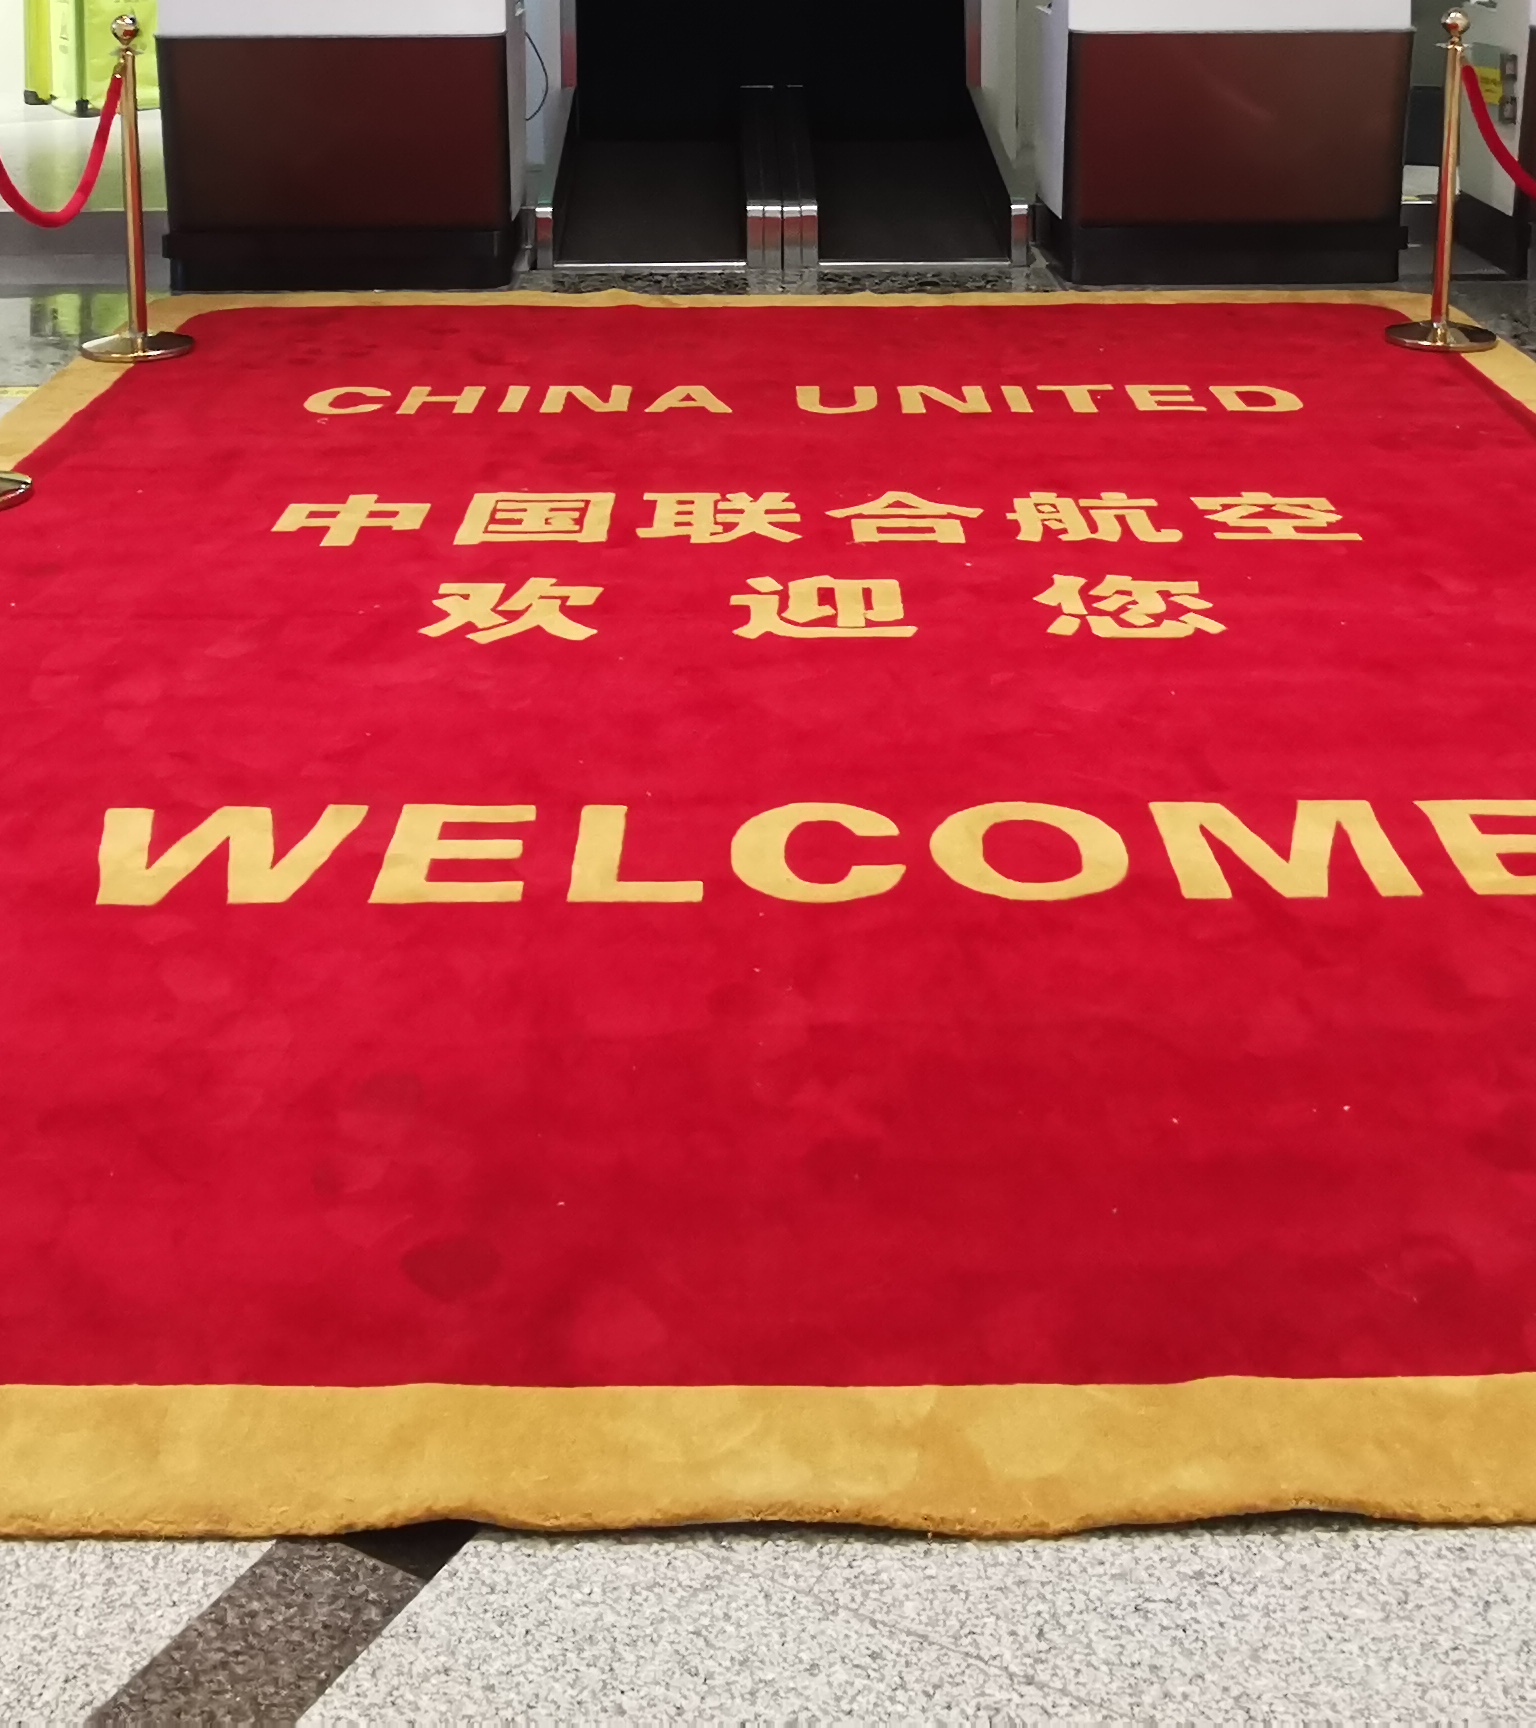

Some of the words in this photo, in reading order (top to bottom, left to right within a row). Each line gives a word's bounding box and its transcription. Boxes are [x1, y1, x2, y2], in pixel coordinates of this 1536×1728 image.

[303, 384, 733, 417] CHINA
[795, 383, 1305, 415] UNITED
[270, 490, 1363, 547] 中国联合航空
[417, 573, 1228, 643] 欢迎您
